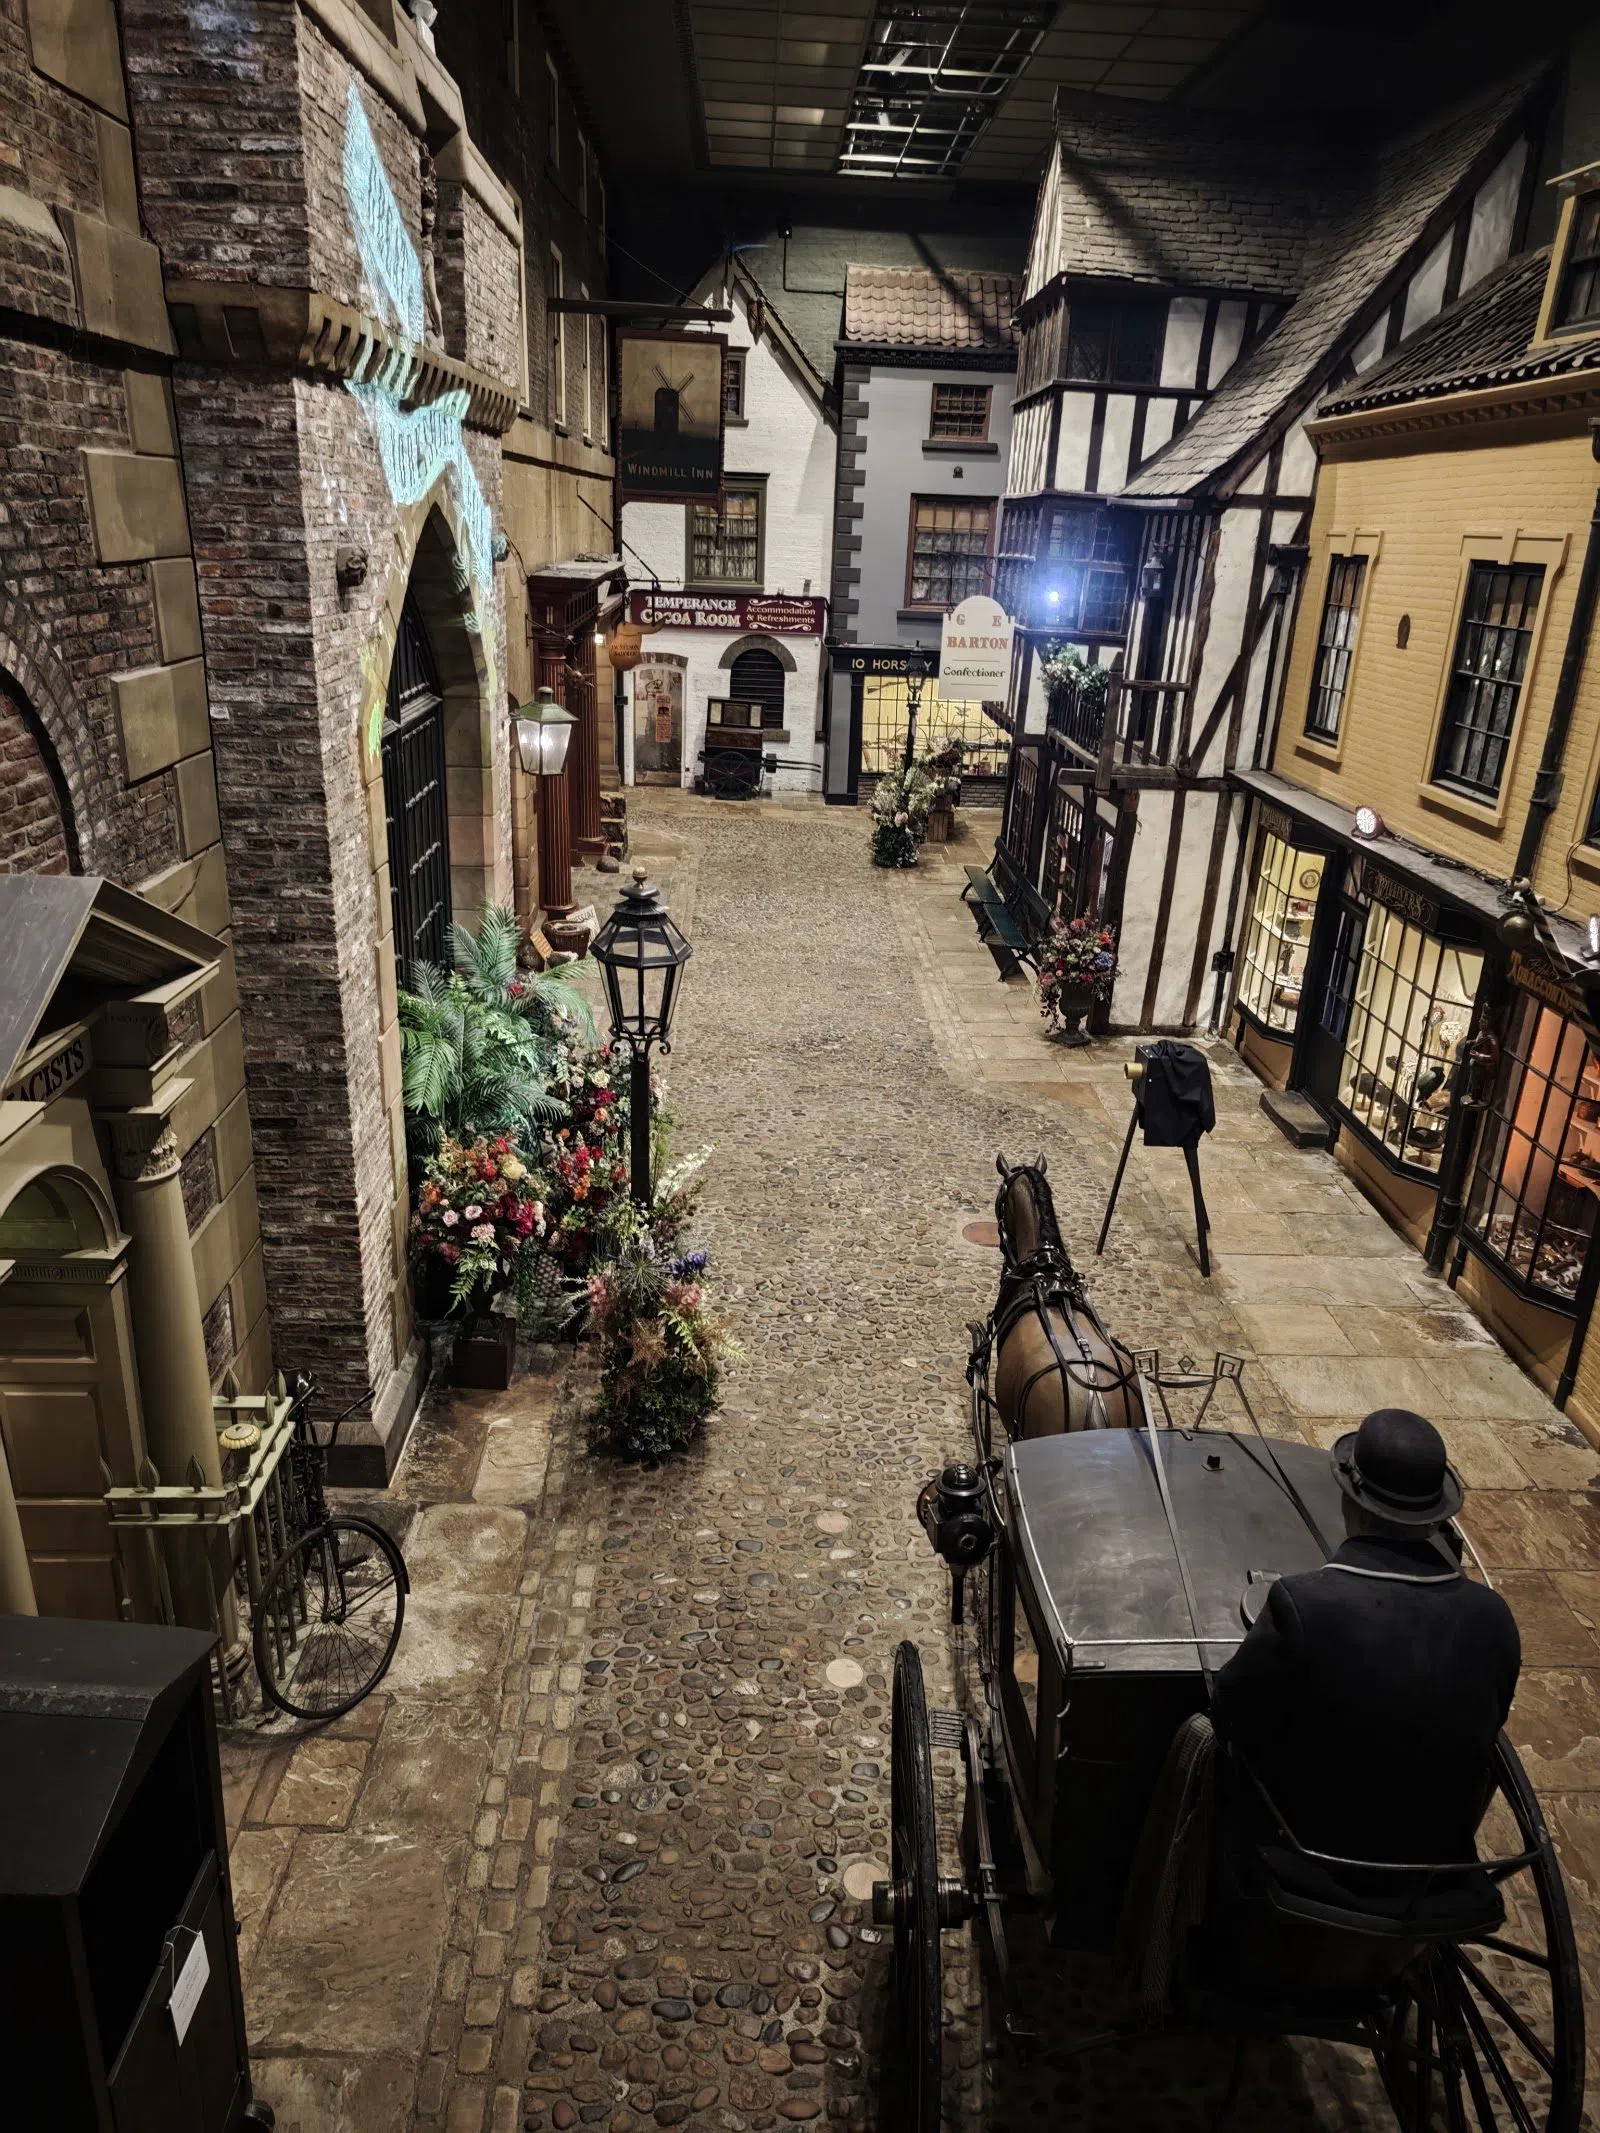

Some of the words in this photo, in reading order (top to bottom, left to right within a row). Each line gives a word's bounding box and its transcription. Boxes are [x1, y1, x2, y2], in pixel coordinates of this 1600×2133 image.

[627, 463, 687, 478] WINDMILL
[691, 466, 713, 479] INN
[645, 596, 737, 612] TEMPERANCE
[746, 605, 816, 615] Accommodation
[640, 609, 692, 626] COCOA
[694, 611, 741, 627] ROOM
[746, 614, 756, 622] &
[757, 614, 815, 624] Refreshments
[956, 613, 966, 626] G
[992, 615, 1002, 627] E
[946, 635, 1009, 650] BARTON
[872, 658, 933, 672] HORSY
[943, 666, 1006, 679] Confectioner
